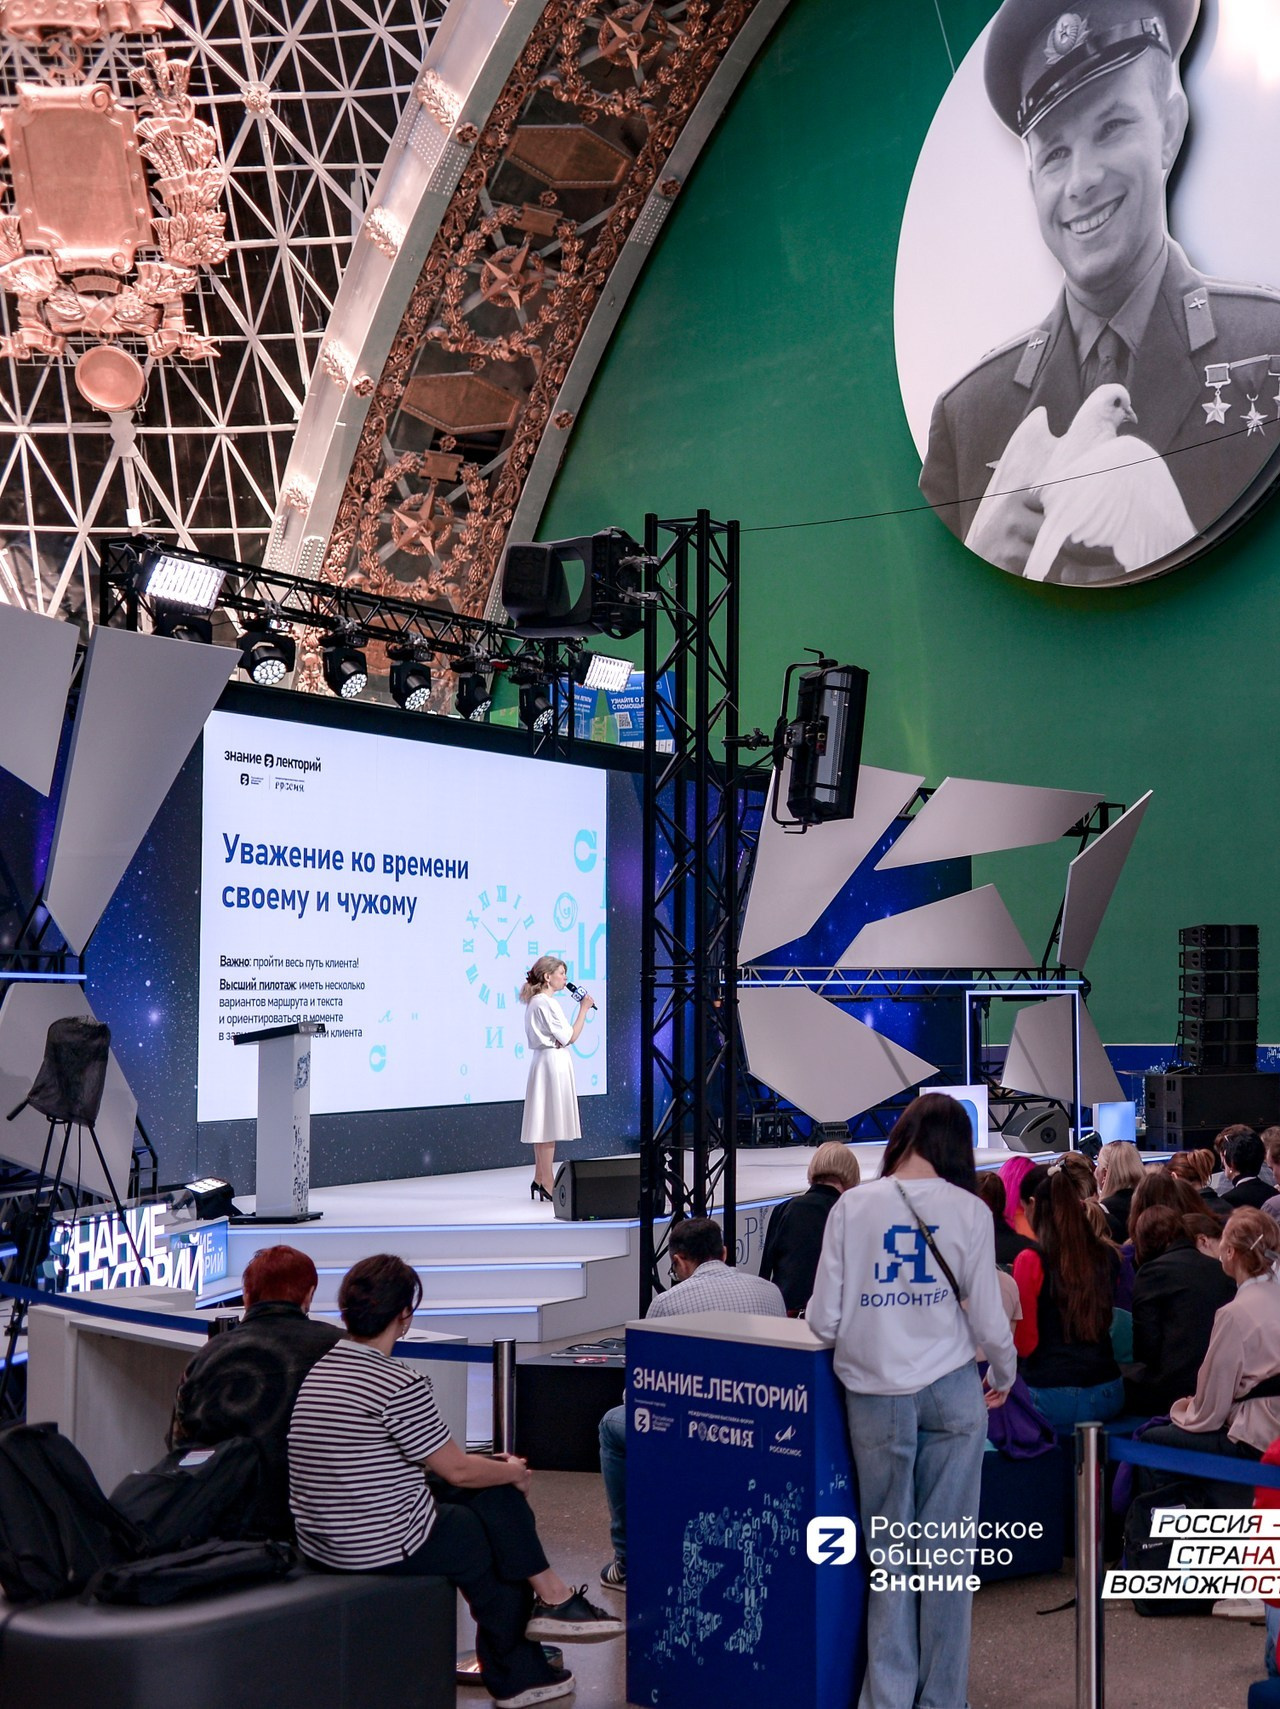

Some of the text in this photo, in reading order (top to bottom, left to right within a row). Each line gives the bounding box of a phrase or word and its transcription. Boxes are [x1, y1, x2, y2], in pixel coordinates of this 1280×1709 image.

[224, 750, 321, 774] знание лекторий
[222, 832, 469, 882] Уважение ко времени
[222, 885, 417, 924] своему и чужому
[220, 955, 359, 971] Важно: пройти весь путь клиента!
[219, 977, 257, 991] Высший
[299, 981, 323, 990] иметь
[325, 981, 366, 990] несколько
[219, 997, 343, 1010] вариантов маршрута и текста
[218, 1015, 225, 1024] и
[226, 1014, 301, 1027] ориентироваться
[309, 1013, 344, 1023] моменте
[218, 1032, 224, 1041] в
[330, 1028, 363, 1039] клиента
[54, 1203, 167, 1275] ЗНАНИЕ
[860, 1288, 949, 1307] ВОЛОНТЁР
[633, 1367, 808, 1414] ЗНАНИЕ.ЛЕКТОРИЙ
[688, 1420, 754, 1449] РОССИЯ
